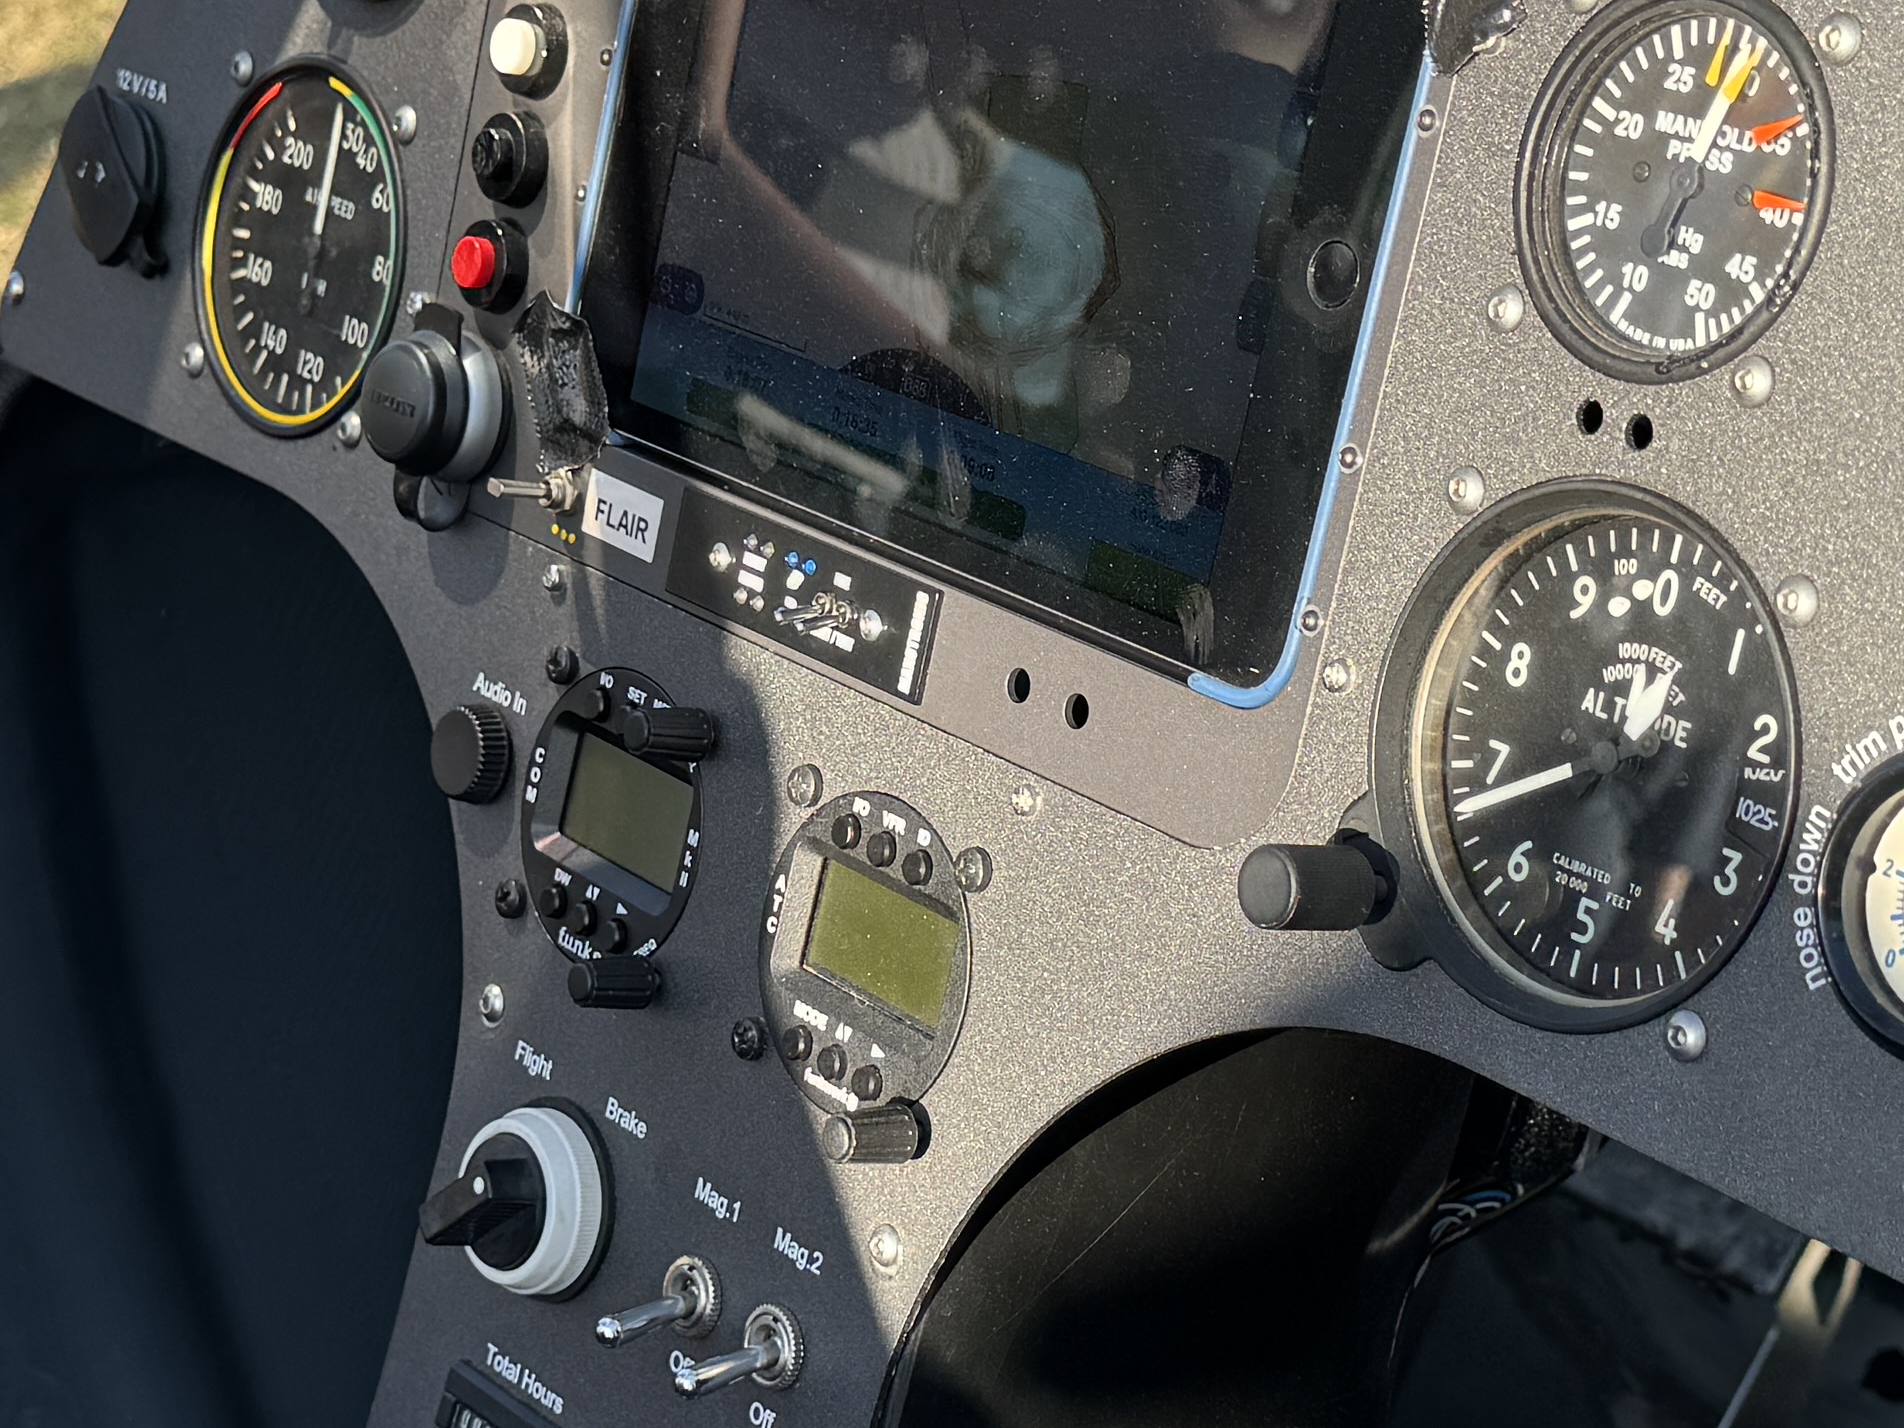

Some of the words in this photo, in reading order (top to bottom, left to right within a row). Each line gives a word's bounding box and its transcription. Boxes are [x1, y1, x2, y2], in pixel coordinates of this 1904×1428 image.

[116, 69, 168, 104] 12V/5A
[1664, 63, 1696, 93] 25
[342, 122, 362, 151] 30
[1614, 110, 1645, 140] 20
[282, 139, 314, 170] 200
[356, 145, 379, 174] 40
[255, 189, 283, 215] 180
[371, 184, 390, 213] 60
[1595, 200, 1623, 231] 15
[1678, 225, 1704, 255] Hg
[246, 252, 273, 287] 160
[371, 255, 391, 284] 80
[1622, 261, 1649, 293] 10
[1725, 252, 1758, 283] 45
[1684, 279, 1716, 310] 50
[260, 320, 287, 355] 140
[341, 315, 368, 348] 100
[1617, 317, 1655, 350] MADE
[1654, 334, 1667, 350] IN
[296, 348, 324, 383] 120
[594, 497, 649, 545] FLAIR
[1613, 559, 1637, 576] 100
[1569, 574, 1597, 620] 9
[1652, 569, 1679, 617] 0
[1693, 576, 1728, 611] FEET
[1505, 641, 1532, 688] 8
[1618, 642, 1649, 660] 1000
[1648, 646, 1683, 673] FEET
[1727, 628, 1746, 675] 1
[472, 671, 513, 709] Audio
[513, 690, 529, 716] In
[627, 685, 648, 706] SET
[1746, 713, 1778, 764] 2
[1487, 738, 1511, 785] 7
[1831, 730, 1888, 784] trim
[524, 746, 546, 804] COM
[1506, 839, 1533, 882] 6
[1787, 803, 1832, 896] down
[553, 867, 573, 887] DW
[1552, 852, 1612, 886] CALIBRATED
[1628, 881, 1642, 898] TO
[1712, 846, 1743, 896] 3
[1882, 858, 1895, 878] 2
[765, 873, 786, 934] ATC
[1605, 890, 1632, 912] FEET
[1570, 895, 1599, 945] 5
[1654, 898, 1678, 946] 4
[1792, 906, 1833, 991] nose
[1885, 948, 1896, 969] 0
[514, 1039, 554, 1081] Flight
[604, 1096, 649, 1140] Brake
[694, 1176, 743, 1224] Mag.1
[773, 1226, 825, 1276] Mag.2
[485, 1342, 522, 1385] Total
[521, 1368, 564, 1415] Hours
